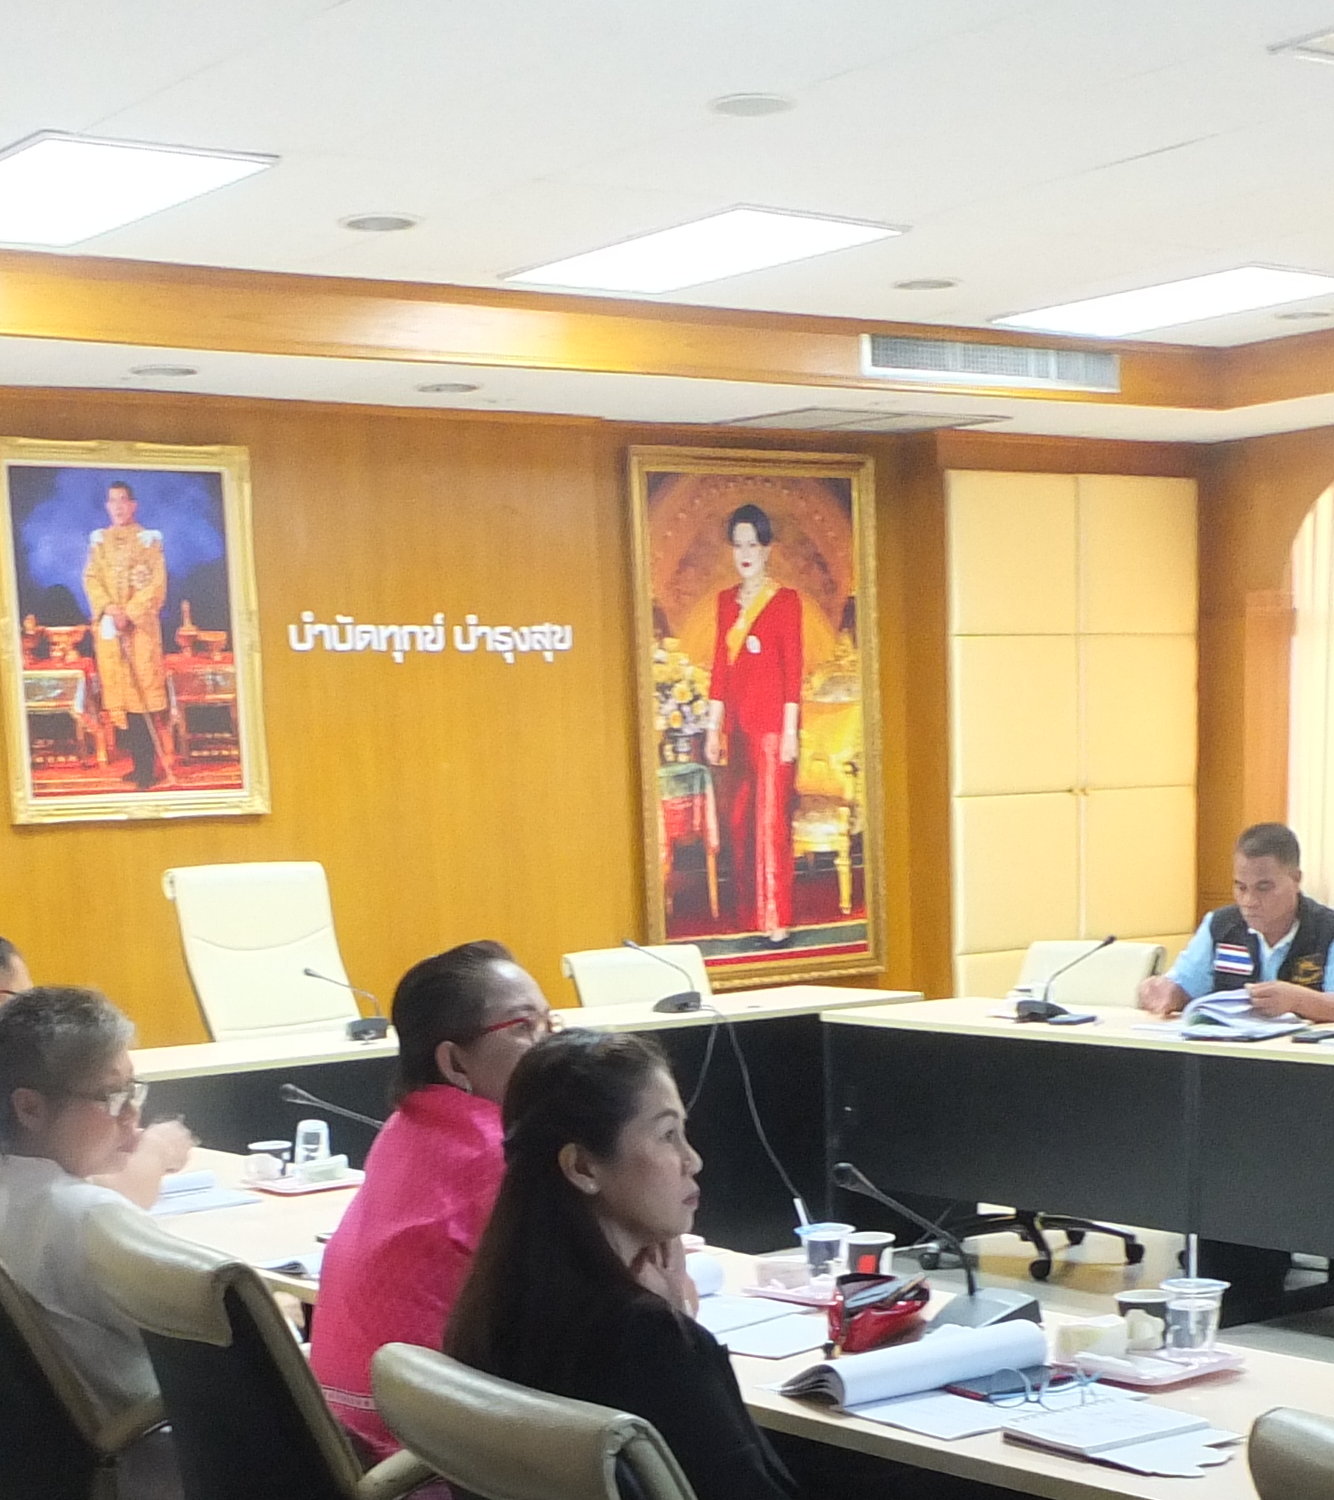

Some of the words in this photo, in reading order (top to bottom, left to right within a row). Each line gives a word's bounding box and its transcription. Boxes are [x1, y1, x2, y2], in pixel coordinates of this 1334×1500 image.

[288, 611, 445, 663] บำบัดทุกข์
[453, 614, 573, 664] บำรุงสุข
